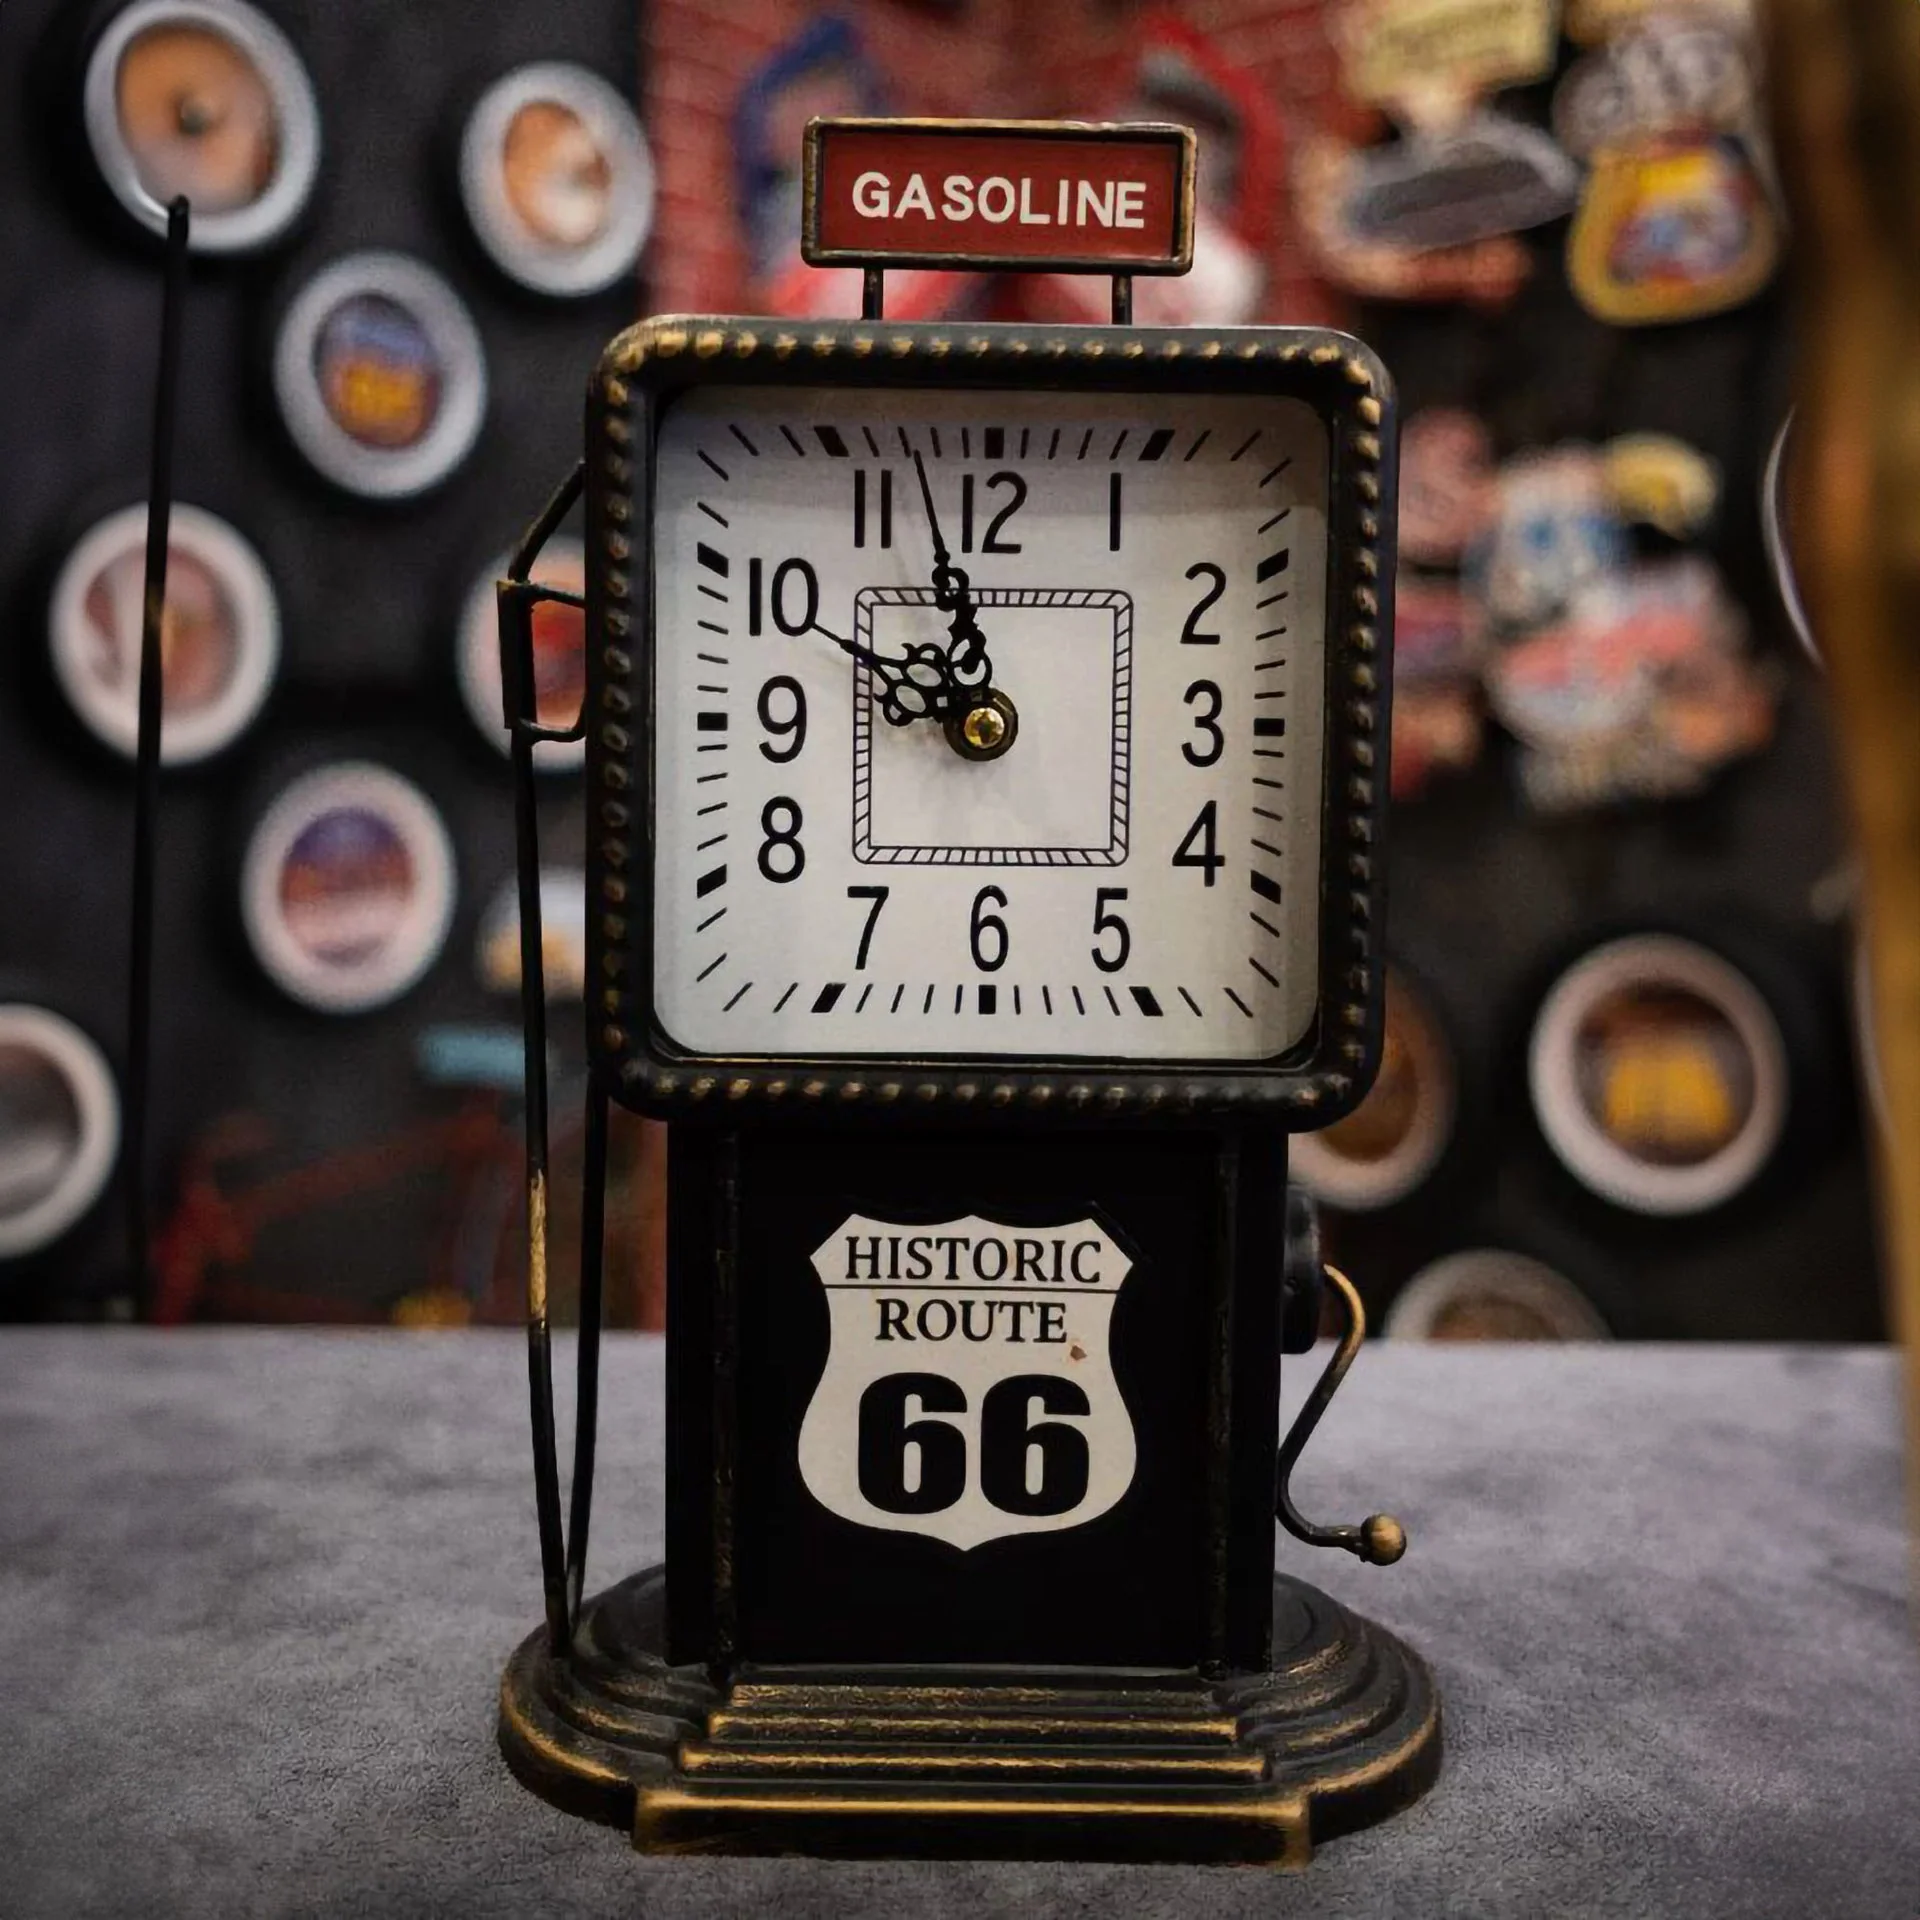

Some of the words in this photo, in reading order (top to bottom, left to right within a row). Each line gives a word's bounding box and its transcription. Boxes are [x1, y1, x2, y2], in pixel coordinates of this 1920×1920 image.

[852, 171, 1147, 230] GASOLINE
[853, 469, 892, 549] 11
[961, 472, 1028, 554] 12
[1109, 472, 1122, 552] 1
[748, 557, 819, 637] 10
[1180, 562, 1227, 645] 2
[756, 675, 807, 763] 9
[1181, 680, 1225, 767] 3
[757, 796, 805, 883] 8
[1172, 800, 1225, 887] 4
[847, 885, 890, 970] 7
[969, 884, 1009, 972] 6
[1091, 887, 1131, 972] 5
[845, 1236, 1102, 1284] HISTORIC
[874, 1298, 1068, 1344] ROUTE
[858, 1372, 1091, 1517] 66
